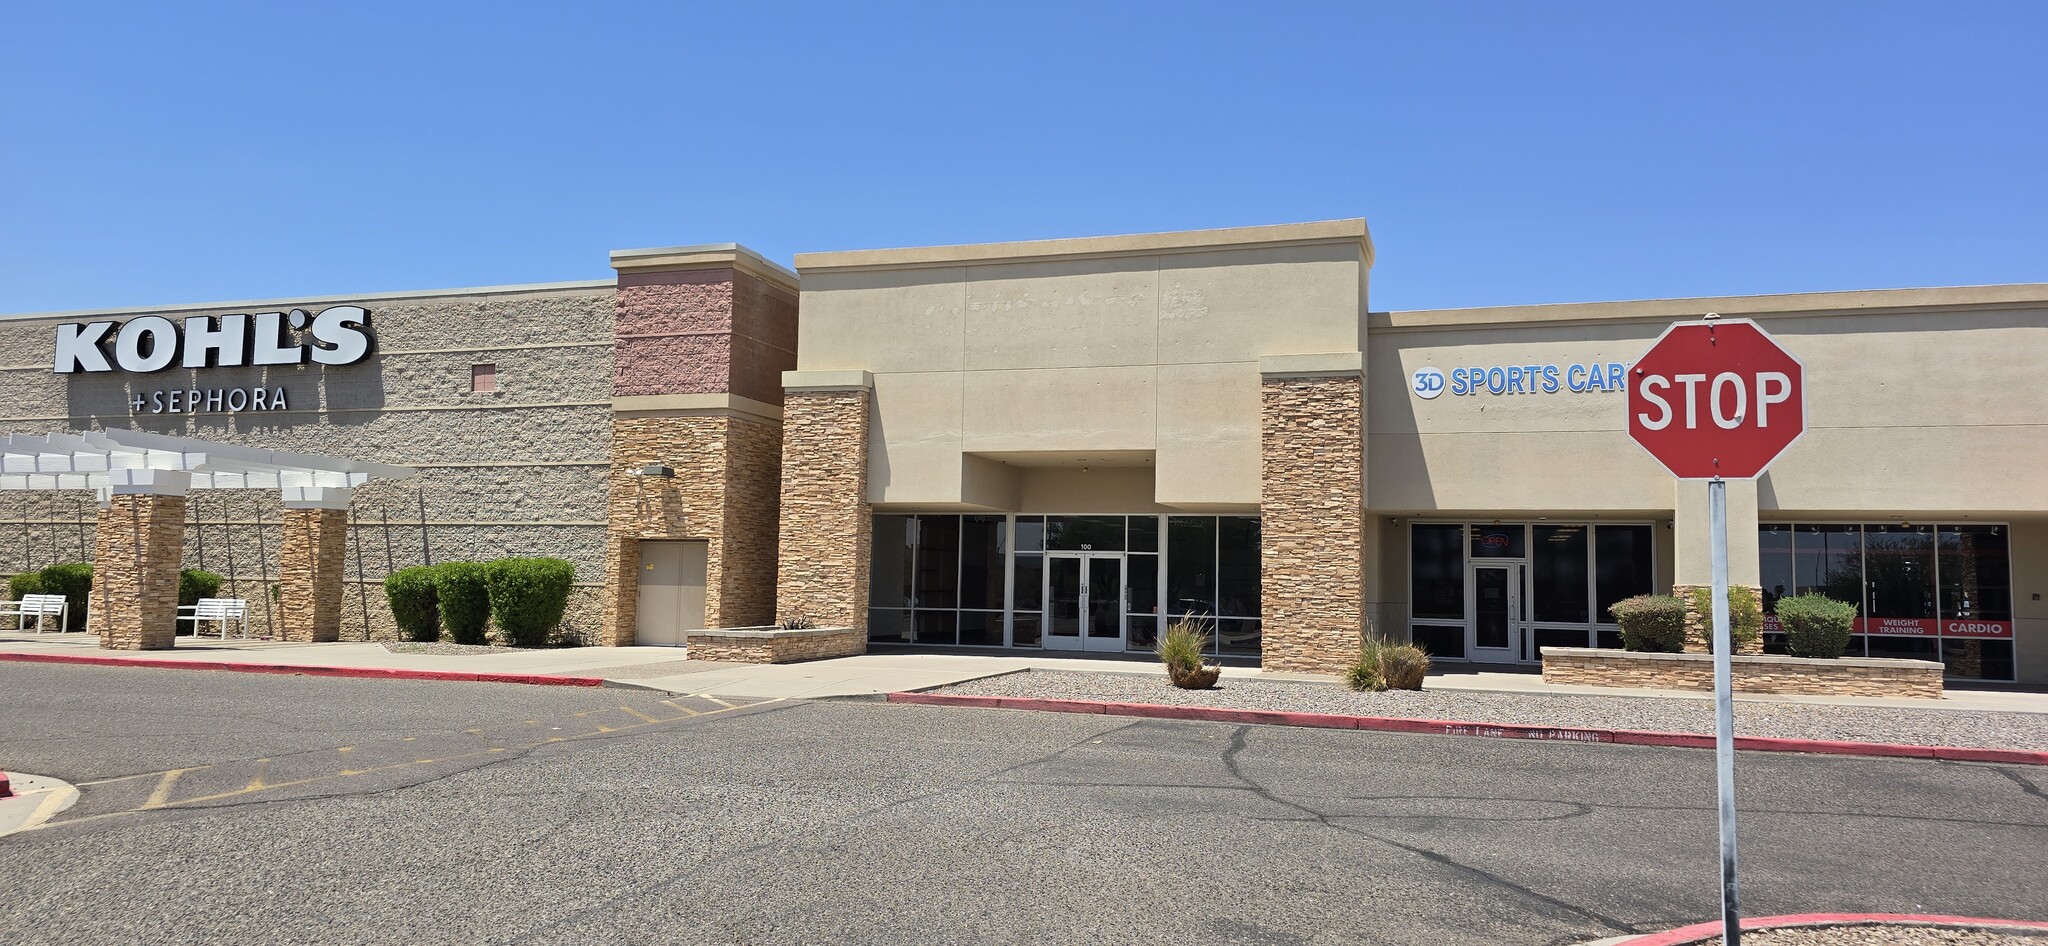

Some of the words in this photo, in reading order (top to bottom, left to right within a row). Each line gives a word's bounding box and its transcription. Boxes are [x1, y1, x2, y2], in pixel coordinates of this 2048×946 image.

[53, 305, 371, 374] KOHL'S
[1415, 373, 1444, 391] 3D
[1451, 364, 1560, 395] SPORTS
[1566, 362, 1629, 392] CAR
[1638, 371, 1792, 431] STOP
[1481, 535, 1508, 547] OPEN
[1883, 619, 1919, 627] WEIGHT
[1949, 623, 2002, 634] CARDIO
[1879, 626, 1924, 634] TRAINING
[1549, 730, 1600, 743] PARKING
